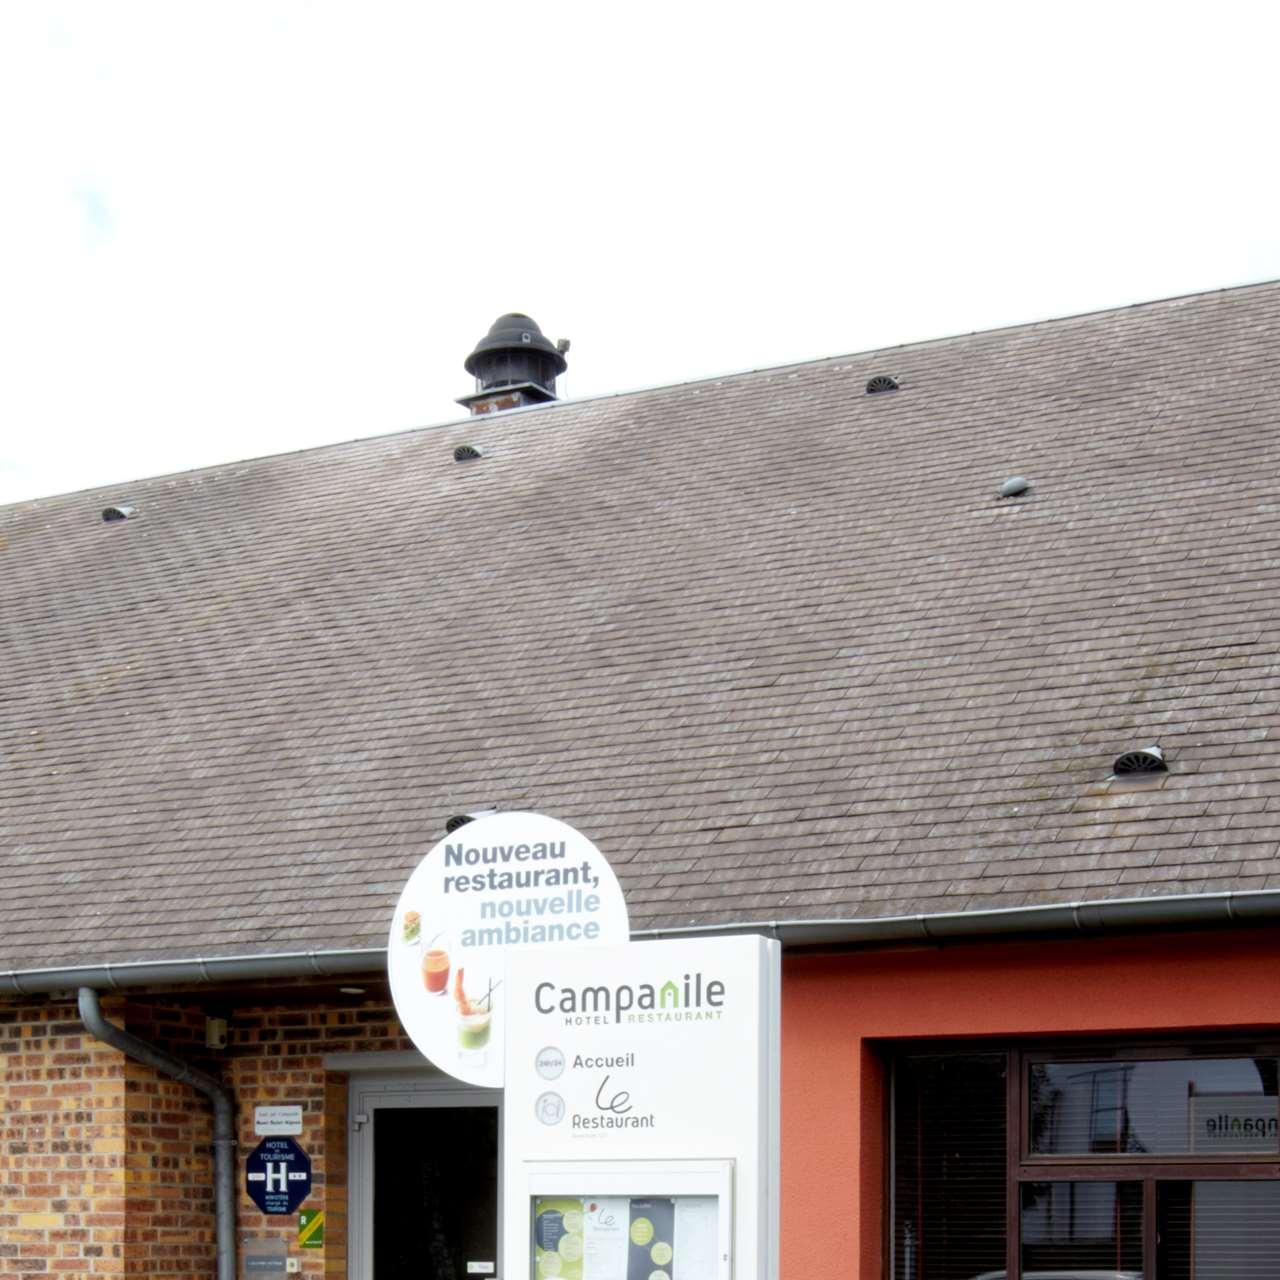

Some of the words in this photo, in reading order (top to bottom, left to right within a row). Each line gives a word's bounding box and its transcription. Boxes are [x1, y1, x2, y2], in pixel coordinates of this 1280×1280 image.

[443, 841, 566, 868] Nouveau
[443, 861, 600, 893] restaurant,
[480, 890, 600, 919] nouvelle
[461, 916, 600, 947] ambiance
[534, 973, 725, 1024] Campanile
[565, 1015, 609, 1026] HOTEL
[628, 1011, 723, 1024] RESTAURANT
[573, 1053, 635, 1069] Accueil
[595, 1075, 633, 1114] Le
[572, 1114, 655, 1129] Restaurant
[266, 1141, 289, 1149] HOTEL
[265, 1162, 288, 1192] H
[300, 1216, 306, 1225] R
